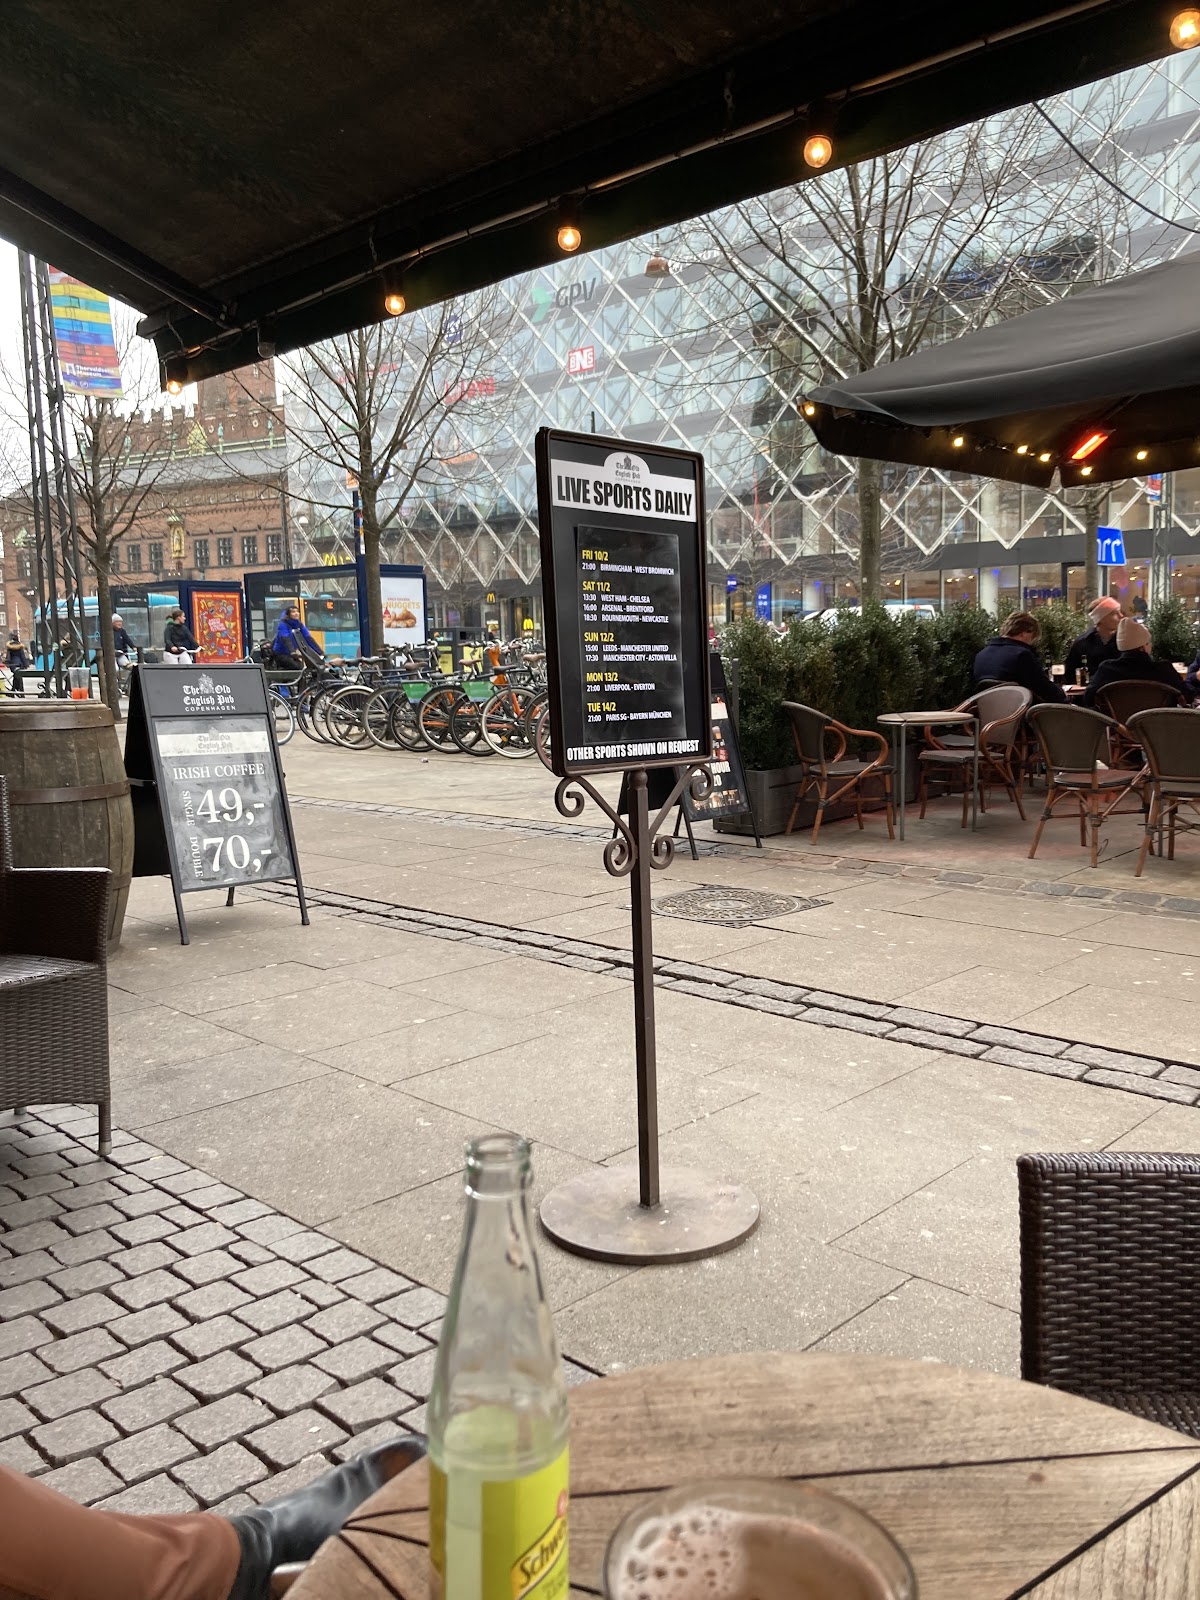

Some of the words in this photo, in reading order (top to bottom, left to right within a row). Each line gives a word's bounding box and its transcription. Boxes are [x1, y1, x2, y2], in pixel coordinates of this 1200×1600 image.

[555, 277, 596, 308] GPV
[557, 475, 591, 504] LIVE
[593, 480, 652, 512] SPORTS
[655, 489, 692, 516] DAILY
[582, 549, 593, 560] FRI
[594, 551, 609, 561] 10/2
[582, 562, 596, 571] 21:00
[600, 564, 632, 573] BIRMINGHAM
[635, 566, 648, 574] WEST
[582, 581, 595, 591] SAT
[596, 582, 610, 592] 11/2
[601, 594, 614, 602] WEST
[601, 604, 623, 612] ARSENAL
[626, 605, 654, 613] BRENTFORD
[601, 614, 640, 622] BOURNEMOUTH
[584, 632, 598, 642] SUN
[600, 632, 614, 642] 12/2
[585, 644, 598, 652] 15:00
[602, 644, 618, 652] LEEDS
[620, 644, 651, 652] MANCHESTER
[652, 644, 669, 652] UNITED
[585, 654, 598, 662] 17:30
[603, 654, 635, 662] MANCHESTER
[636, 654, 646, 662] CITY
[648, 654, 663, 662] ASTON
[587, 672, 603, 682] MON
[604, 672, 618, 682] 13/2
[182, 685, 200, 695] The
[215, 685, 231, 694] Old
[586, 684, 600, 692] 21:00
[604, 684, 631, 692] LIVERPOOL
[634, 683, 655, 691] EVERTON
[183, 695, 215, 706] English
[217, 695, 235, 705] Pub
[587, 702, 601, 712] TUE
[602, 702, 616, 712] 14/2
[620, 713, 627, 721] SG
[630, 712, 648, 720] BAYERN
[567, 746, 594, 761] OTHER
[595, 744, 626, 760] SPORTS
[626, 742, 656, 758] SHOWN
[657, 741, 668, 754] ON
[668, 739, 699, 755] REQUEST
[173, 766, 211, 780] IRISH
[215, 763, 265, 777] COFFEE
[711, 761, 731, 775] HOUR
[181, 790, 196, 827] SINGLE
[189, 836, 204, 878] DOUBLE
